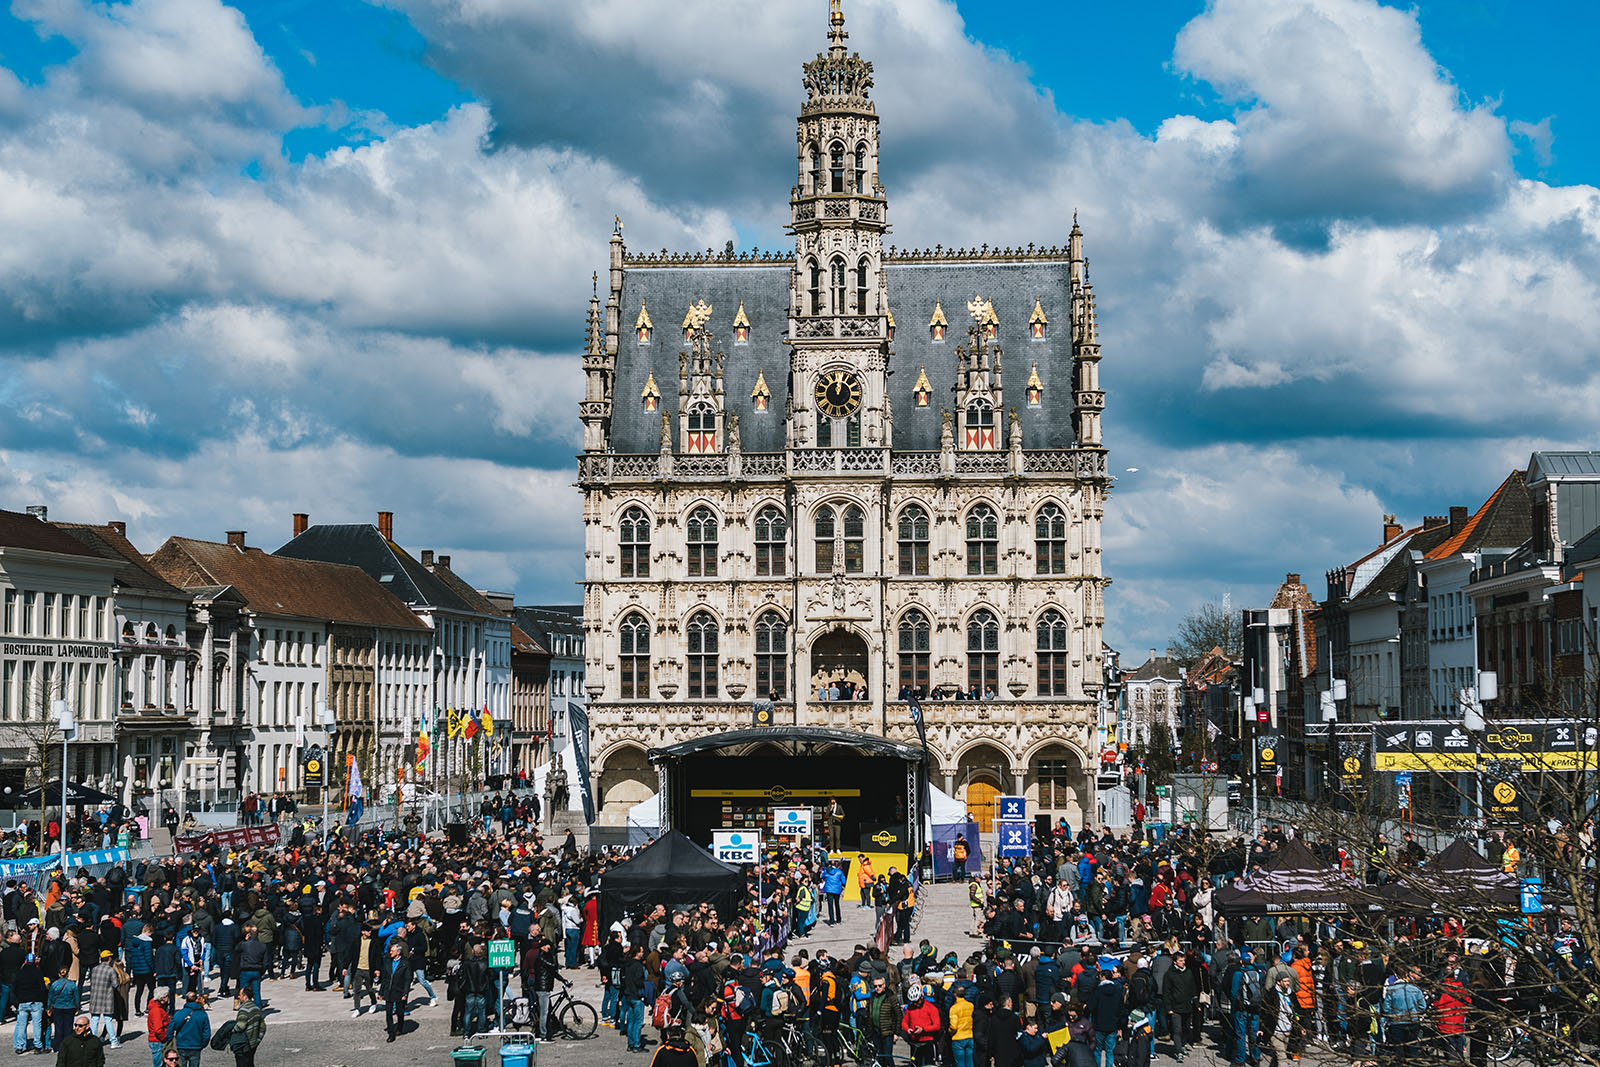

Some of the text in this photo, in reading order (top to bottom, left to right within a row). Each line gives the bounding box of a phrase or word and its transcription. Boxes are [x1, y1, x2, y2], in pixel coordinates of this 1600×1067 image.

[3, 644, 53, 656] HOSTELLERIE
[720, 851, 753, 860] KBC
[490, 944, 513, 952] AFVAL
[493, 956, 511, 965] HIER
